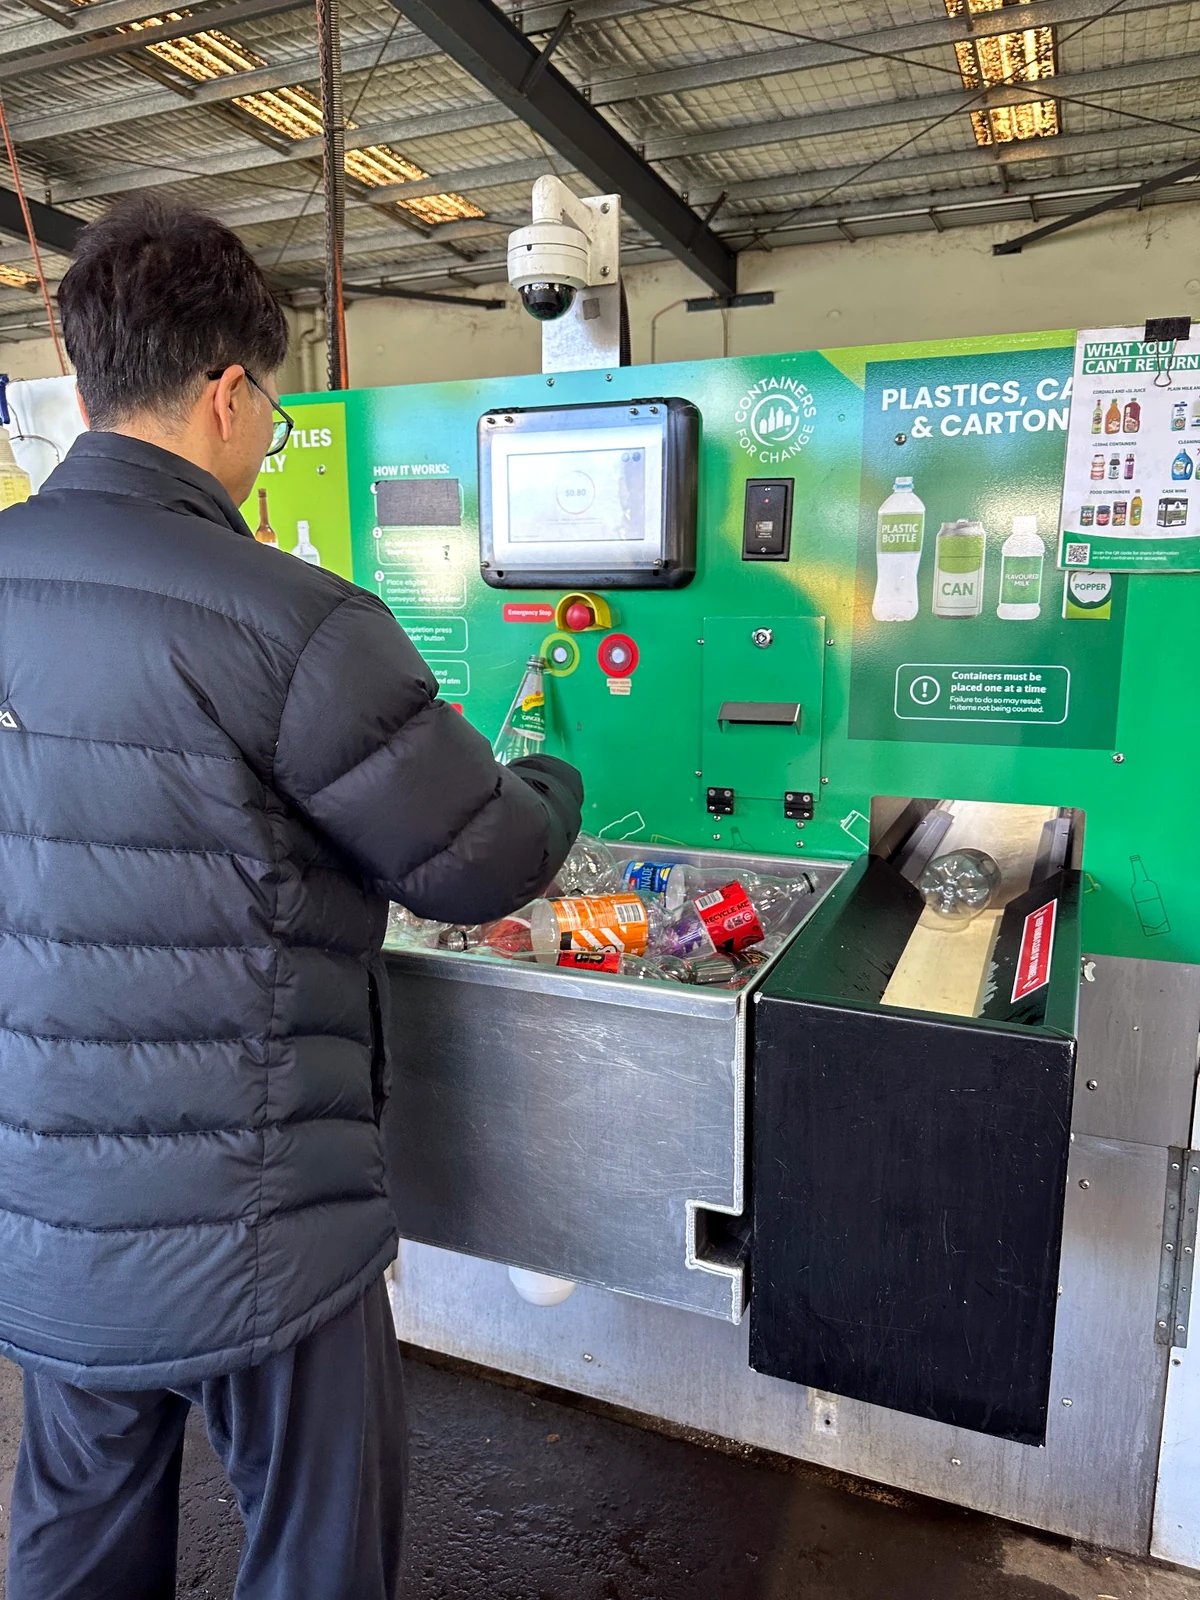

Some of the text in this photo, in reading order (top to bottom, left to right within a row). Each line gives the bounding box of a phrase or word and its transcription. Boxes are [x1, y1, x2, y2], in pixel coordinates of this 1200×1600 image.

[1086, 341, 1170, 357] WHAT YOU
[1086, 356, 1199, 373] CAN'T RETURN
[735, 376, 816, 423] CONTAINERS
[881, 377, 1072, 411] PLASTICS, CA
[911, 408, 1069, 438] & CARTON
[290, 428, 332, 448] TLES
[736, 424, 814, 464] FOR CHANGE
[373, 464, 450, 476] HOW IT WORKS:
[565, 489, 586, 497] $0.80
[882, 523, 918, 534] PLASTIC
[882, 533, 917, 544] BOTTLE
[942, 583, 973, 596] CAN
[1074, 583, 1107, 591] POPPER
[952, 671, 1002, 680] Containers
[1029, 672, 1042, 681] be
[951, 683, 982, 693] placed
[1024, 685, 1046, 693] time
[990, 705, 1011, 714] being
[703, 901, 749, 925] RECYCLE ME
